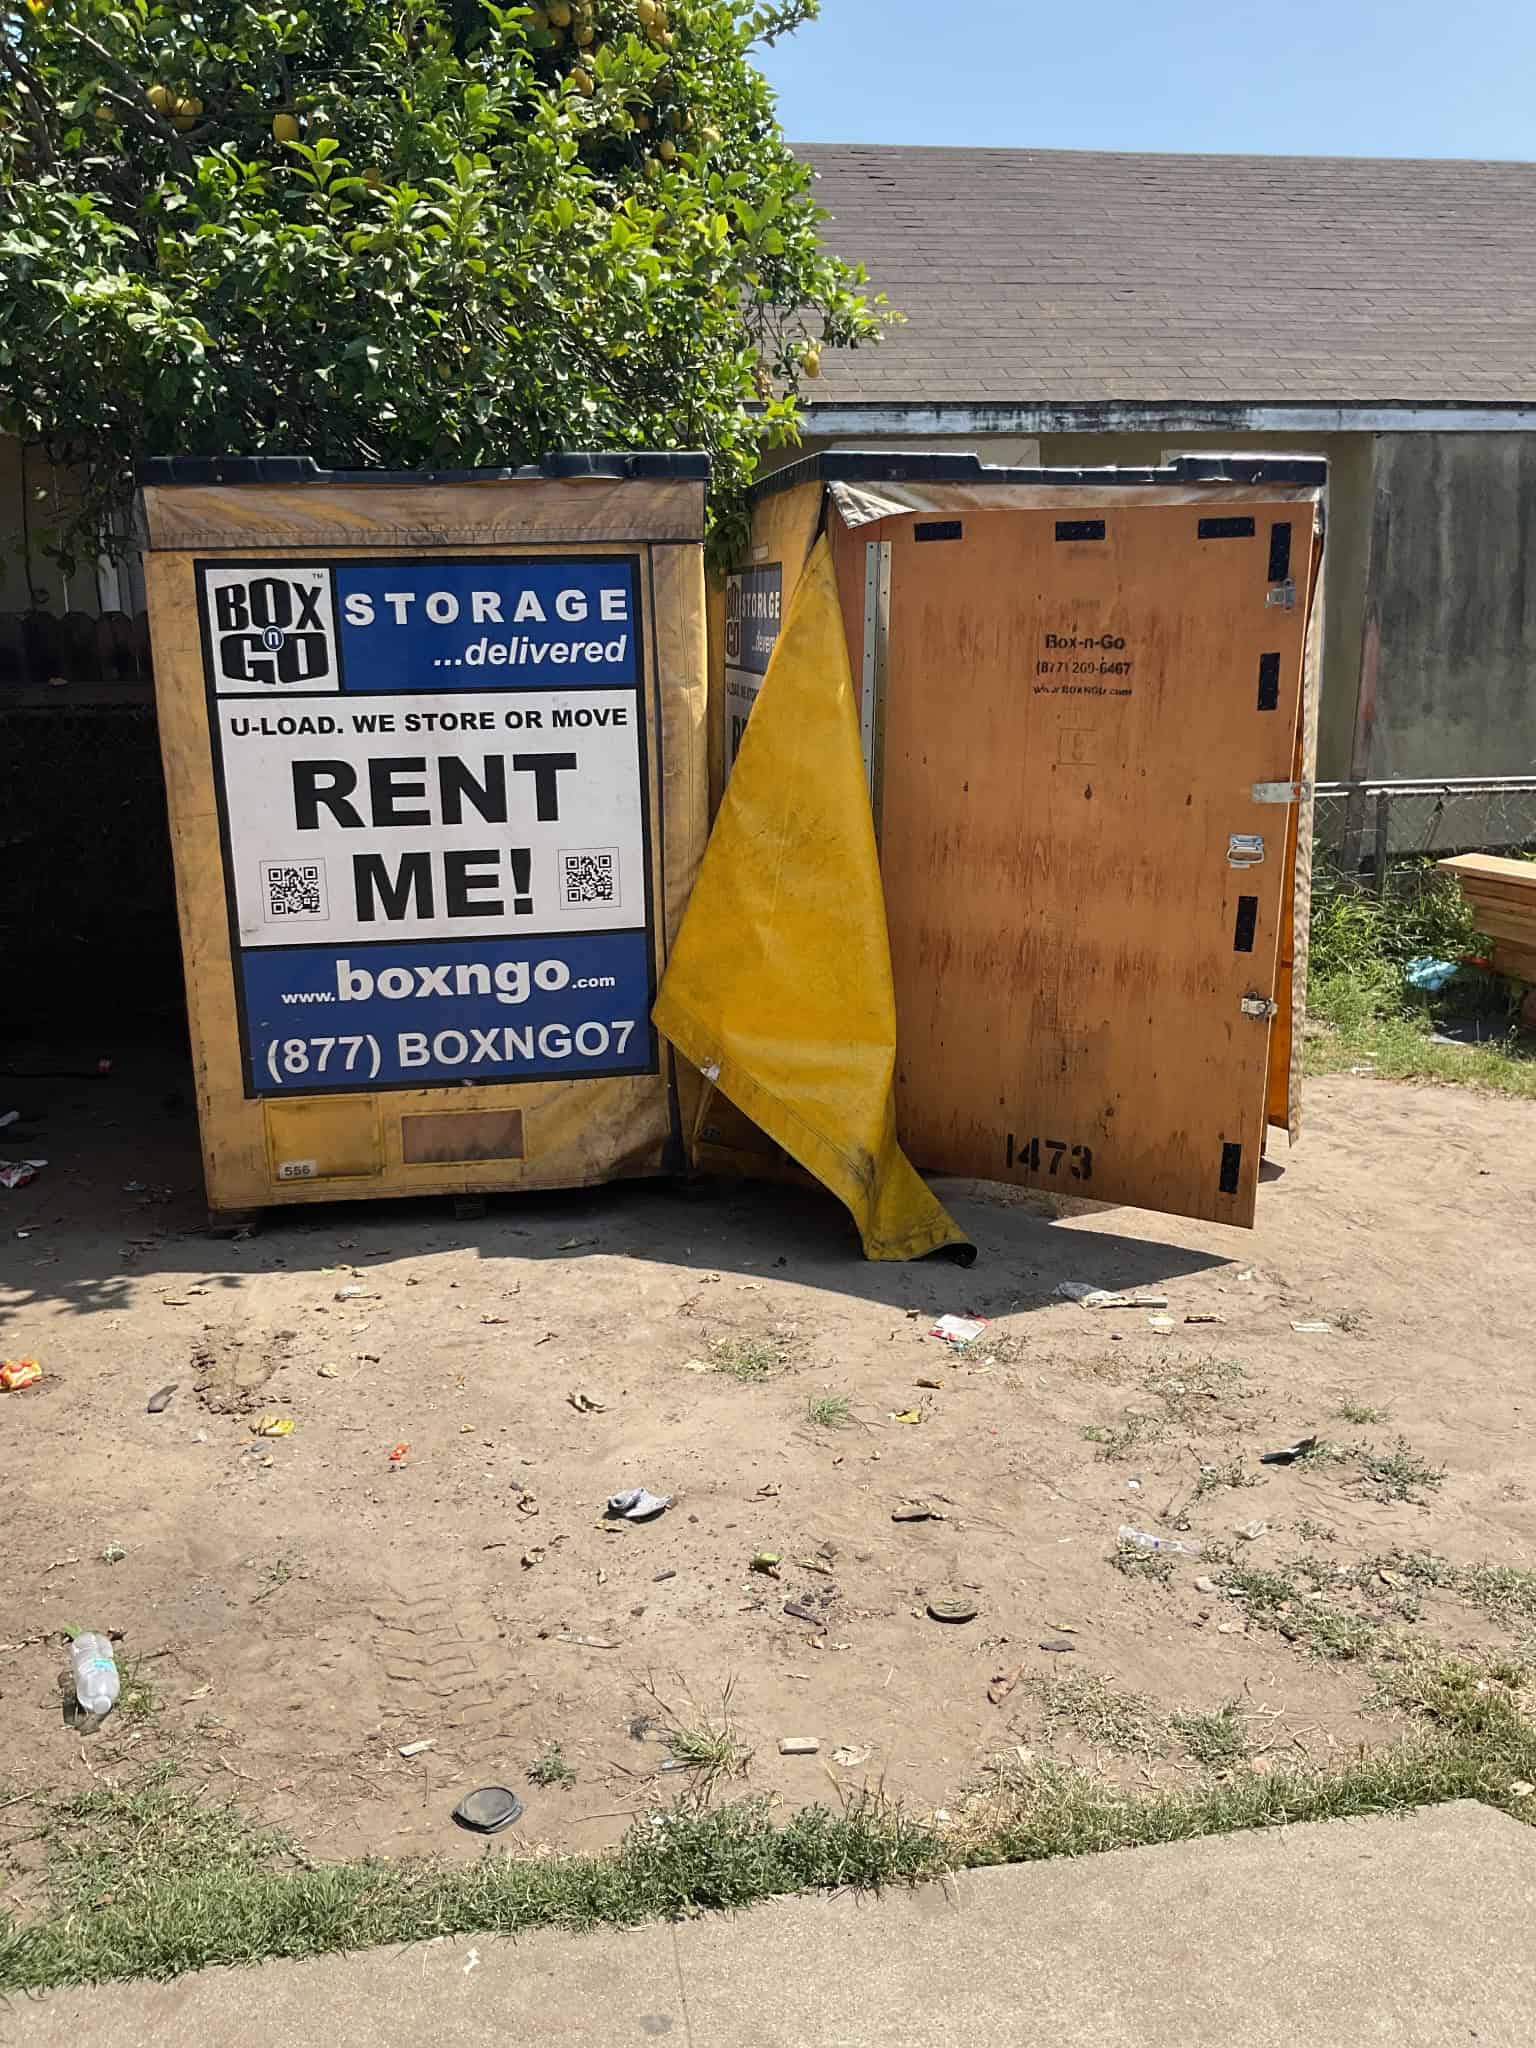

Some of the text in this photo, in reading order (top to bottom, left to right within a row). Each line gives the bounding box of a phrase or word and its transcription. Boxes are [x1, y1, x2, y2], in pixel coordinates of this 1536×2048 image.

[214, 577, 326, 632] BOX
[344, 588, 629, 627] STORAGE
[220, 632, 330, 685] GO
[433, 634, 627, 668] ...delivered
[1045, 633, 1125, 650] Box-n-Go
[230, 707, 628, 737] U-LOAD. WE STORE OR MOVE
[291, 752, 578, 831] RENT
[352, 847, 535, 923] ME!
[266, 1019, 636, 1083] (877) BOXNGO7
[284, 1165, 311, 1177] 556
[1006, 1133, 1093, 1180] 1473
